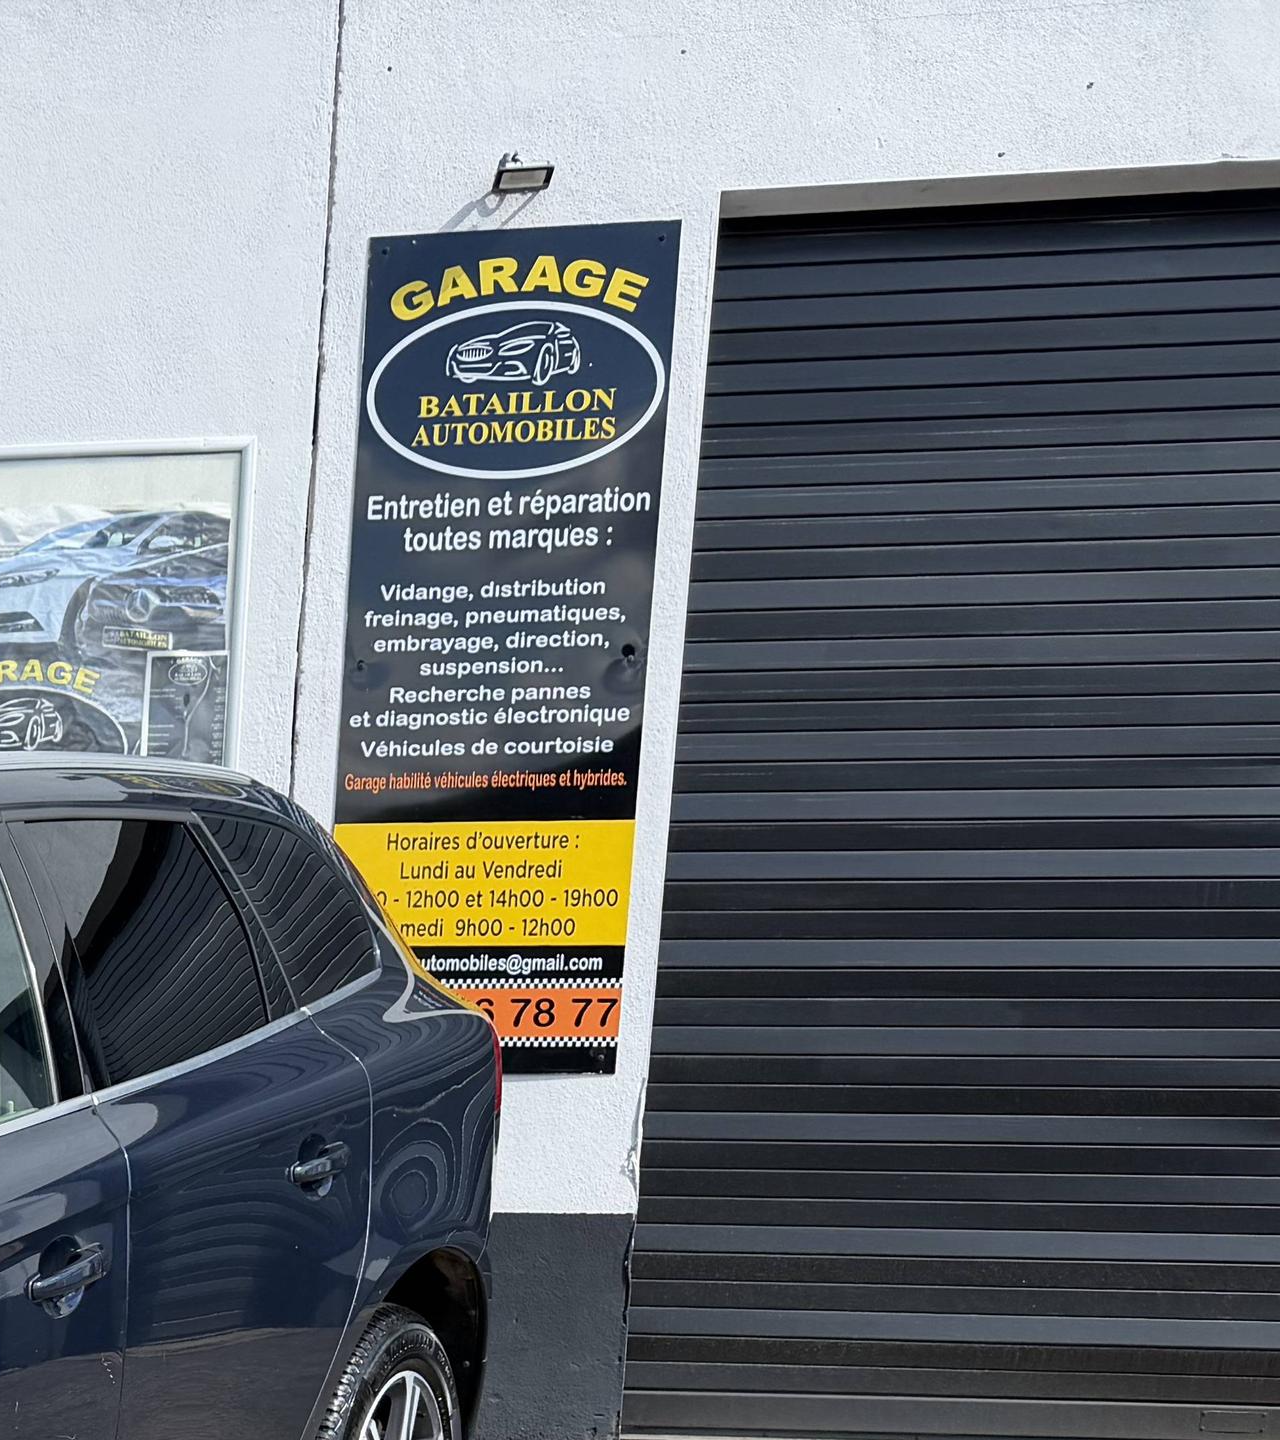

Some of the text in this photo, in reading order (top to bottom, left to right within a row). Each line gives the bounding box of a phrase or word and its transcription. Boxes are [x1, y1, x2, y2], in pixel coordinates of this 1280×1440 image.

[390, 255, 649, 321] GARAGE
[418, 387, 617, 418] BATAILLON
[411, 417, 616, 447] AUTOMOBILES
[367, 486, 651, 521] Entretien et réparation
[403, 527, 482, 552] toutes
[489, 525, 598, 553] marques
[380, 578, 606, 604] Vidange, distribution
[364, 606, 627, 631] freinage, pneumatiques,
[373, 631, 610, 654] embrayage, direction,
[420, 658, 564, 679] suspension...
[389, 684, 591, 704] Recherche pannes
[349, 705, 631, 732] et diagnostic électronique
[361, 736, 614, 758] Véhicules de courtoisie
[345, 769, 627, 794] Garage habilité véhicules électriques et hybrides.
[386, 832, 460, 852] Horaires
[400, 860, 562, 880] Lundi au Vendredi
[405, 890, 460, 909] 12h00
[465, 891, 483, 908] et
[489, 889, 544, 908] 14h00
[563, 888, 619, 907] 19h00
[401, 918, 444, 937] medi
[455, 918, 503, 937] 9h00
[521, 918, 576, 937] 12h00
[419, 954, 603, 975] utomobiles@gmail.com
[511, 998, 556, 1028] 78
[571, 998, 620, 1028] 77
